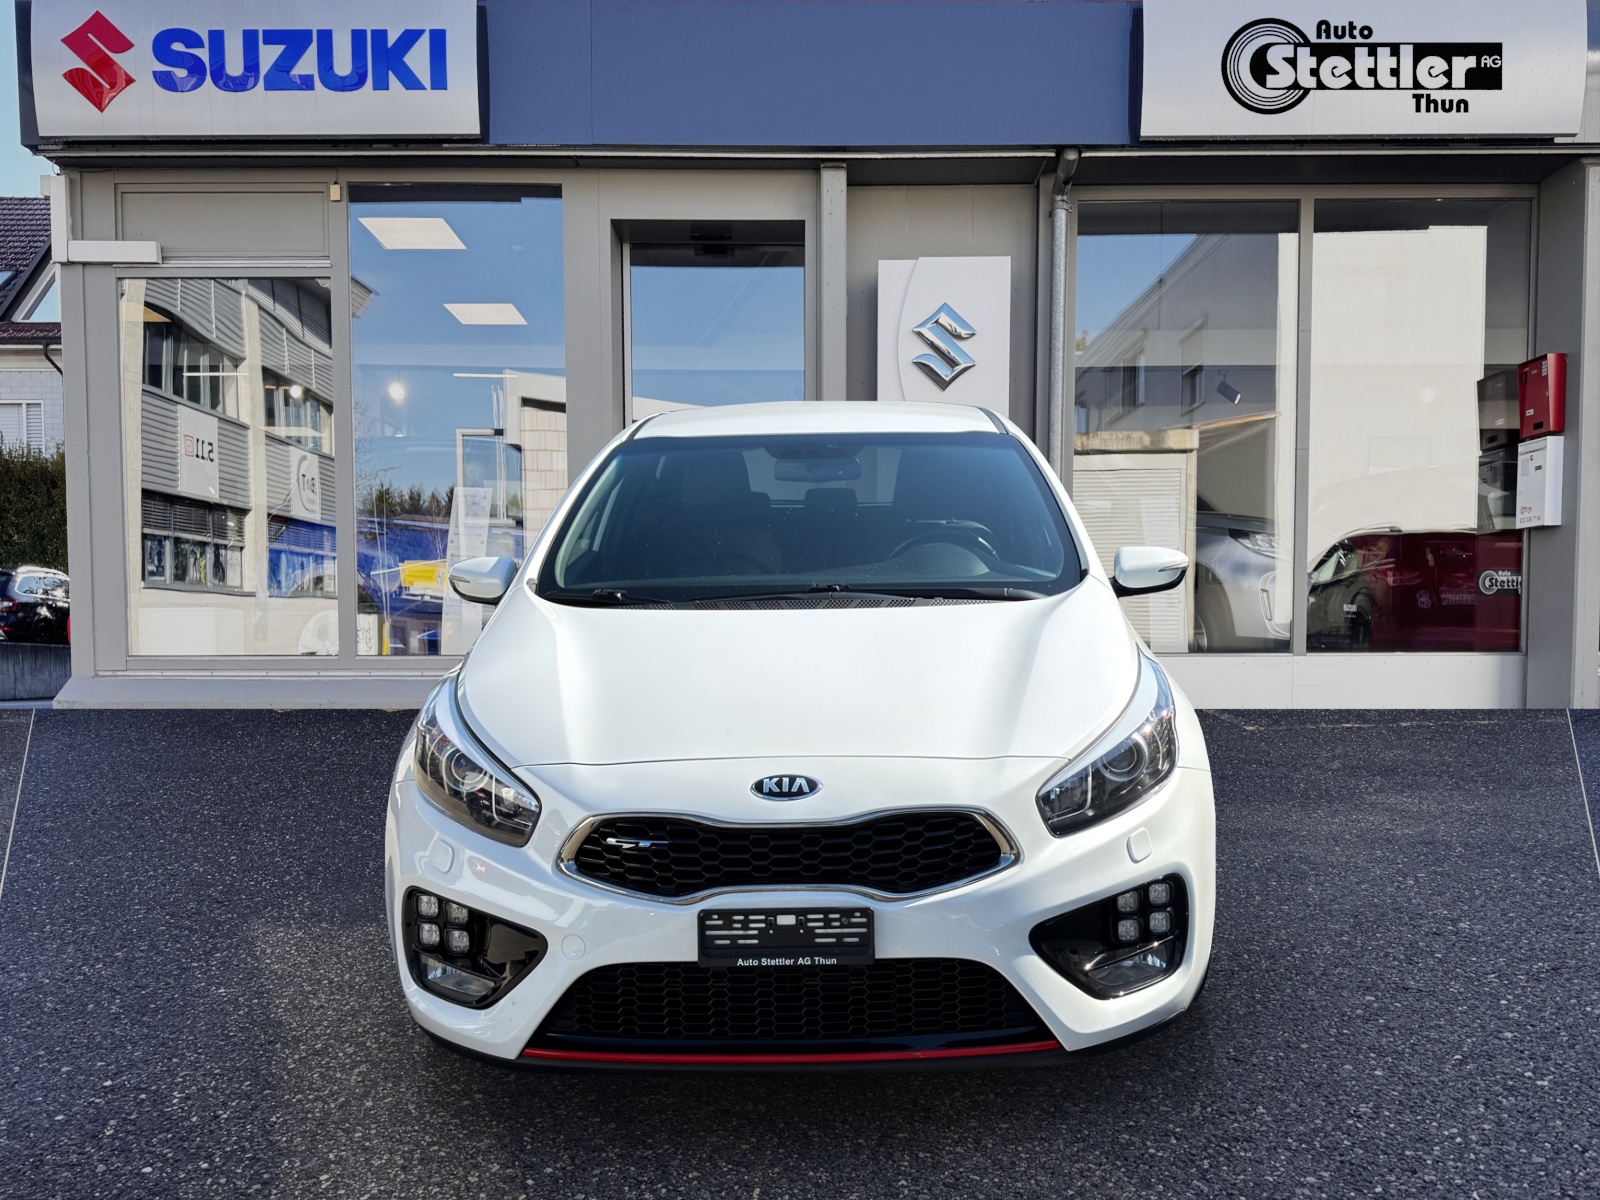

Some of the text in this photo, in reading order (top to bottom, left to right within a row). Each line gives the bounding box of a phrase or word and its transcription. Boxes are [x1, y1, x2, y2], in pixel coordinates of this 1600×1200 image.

[1316, 19, 1374, 40] Auto
[151, 27, 448, 93] SUZUKI
[1265, 44, 1502, 89] Stettler AG
[1412, 93, 1469, 113] Thun
[762, 777, 810, 794] KIA
[737, 956, 837, 966] Auto Stettler AG Thun
